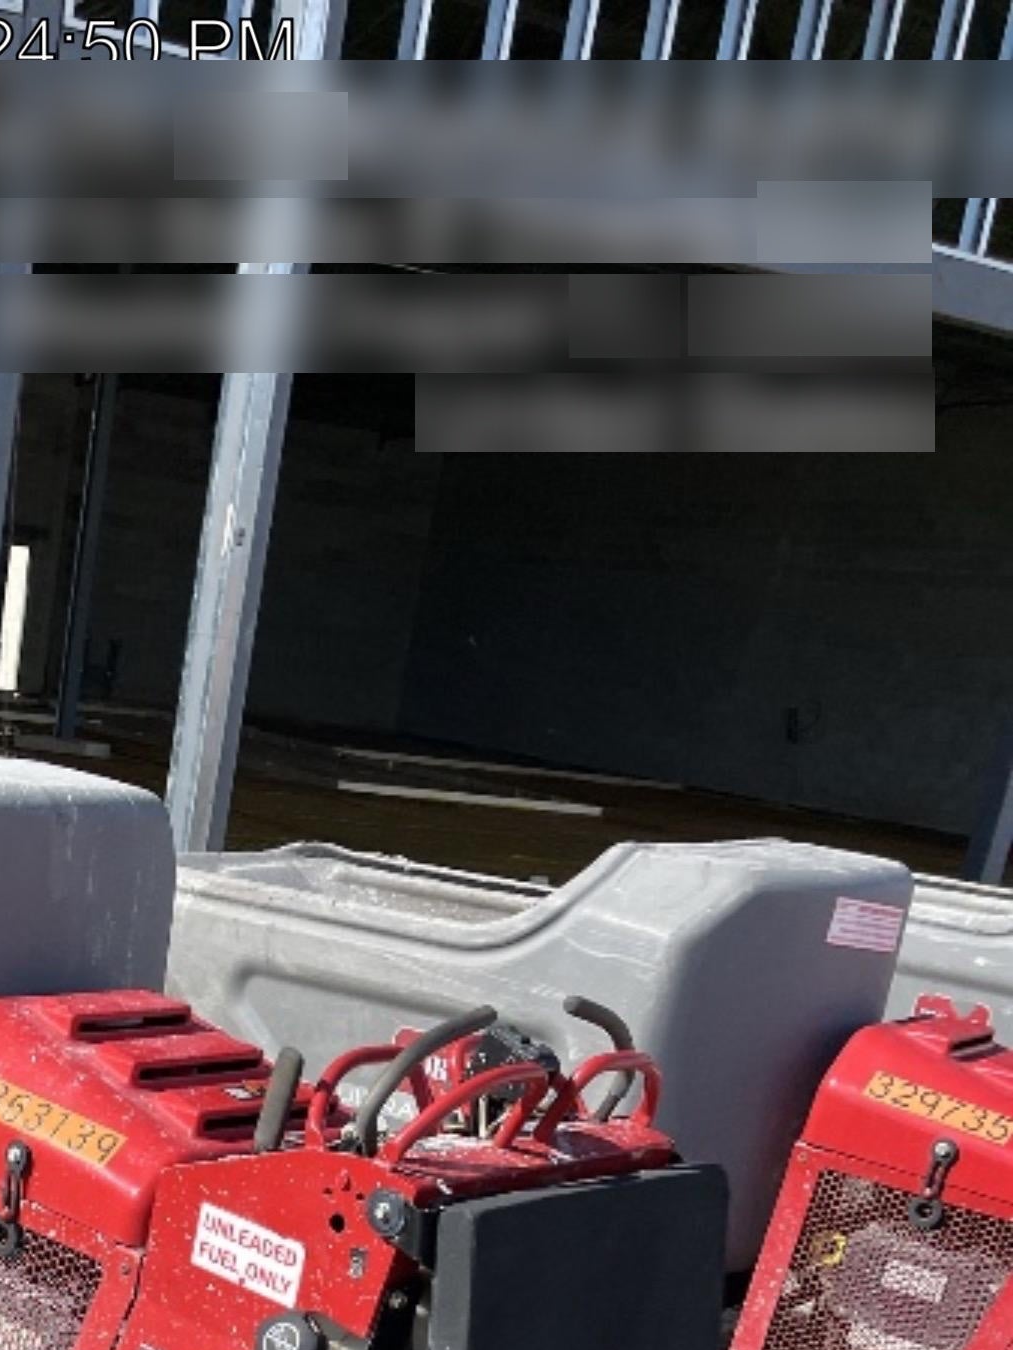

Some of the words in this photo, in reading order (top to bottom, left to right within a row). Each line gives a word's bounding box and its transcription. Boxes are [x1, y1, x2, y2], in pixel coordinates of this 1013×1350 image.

[868, 1073, 1013, 1141] 329735
[203, 1211, 298, 1267] UNLEADED
[199, 1241, 239, 1274] FUEL
[245, 1262, 293, 1295] ONLY
